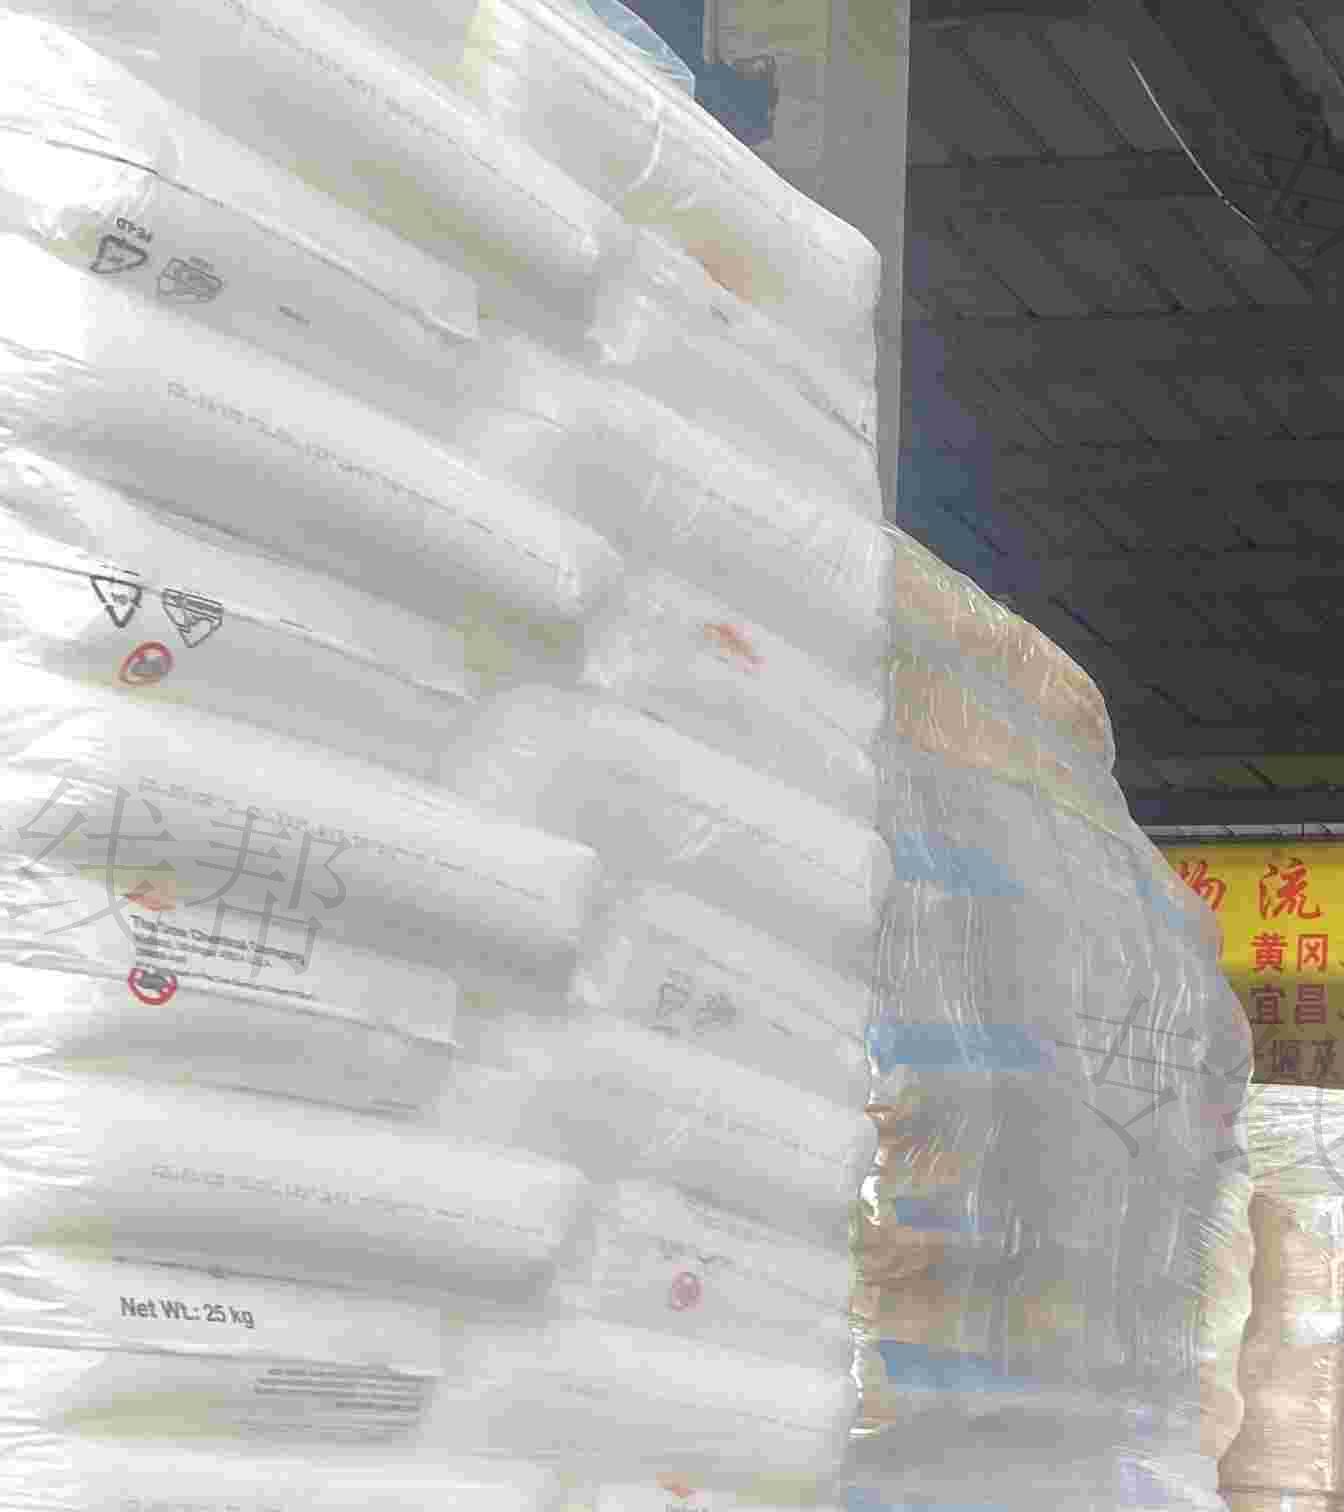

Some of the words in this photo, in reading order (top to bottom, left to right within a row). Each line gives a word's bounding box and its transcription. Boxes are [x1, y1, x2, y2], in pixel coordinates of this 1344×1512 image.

[120, 1296, 157, 1319] Net
[202, 1303, 226, 1323] 25
[229, 1306, 255, 1330] kg
